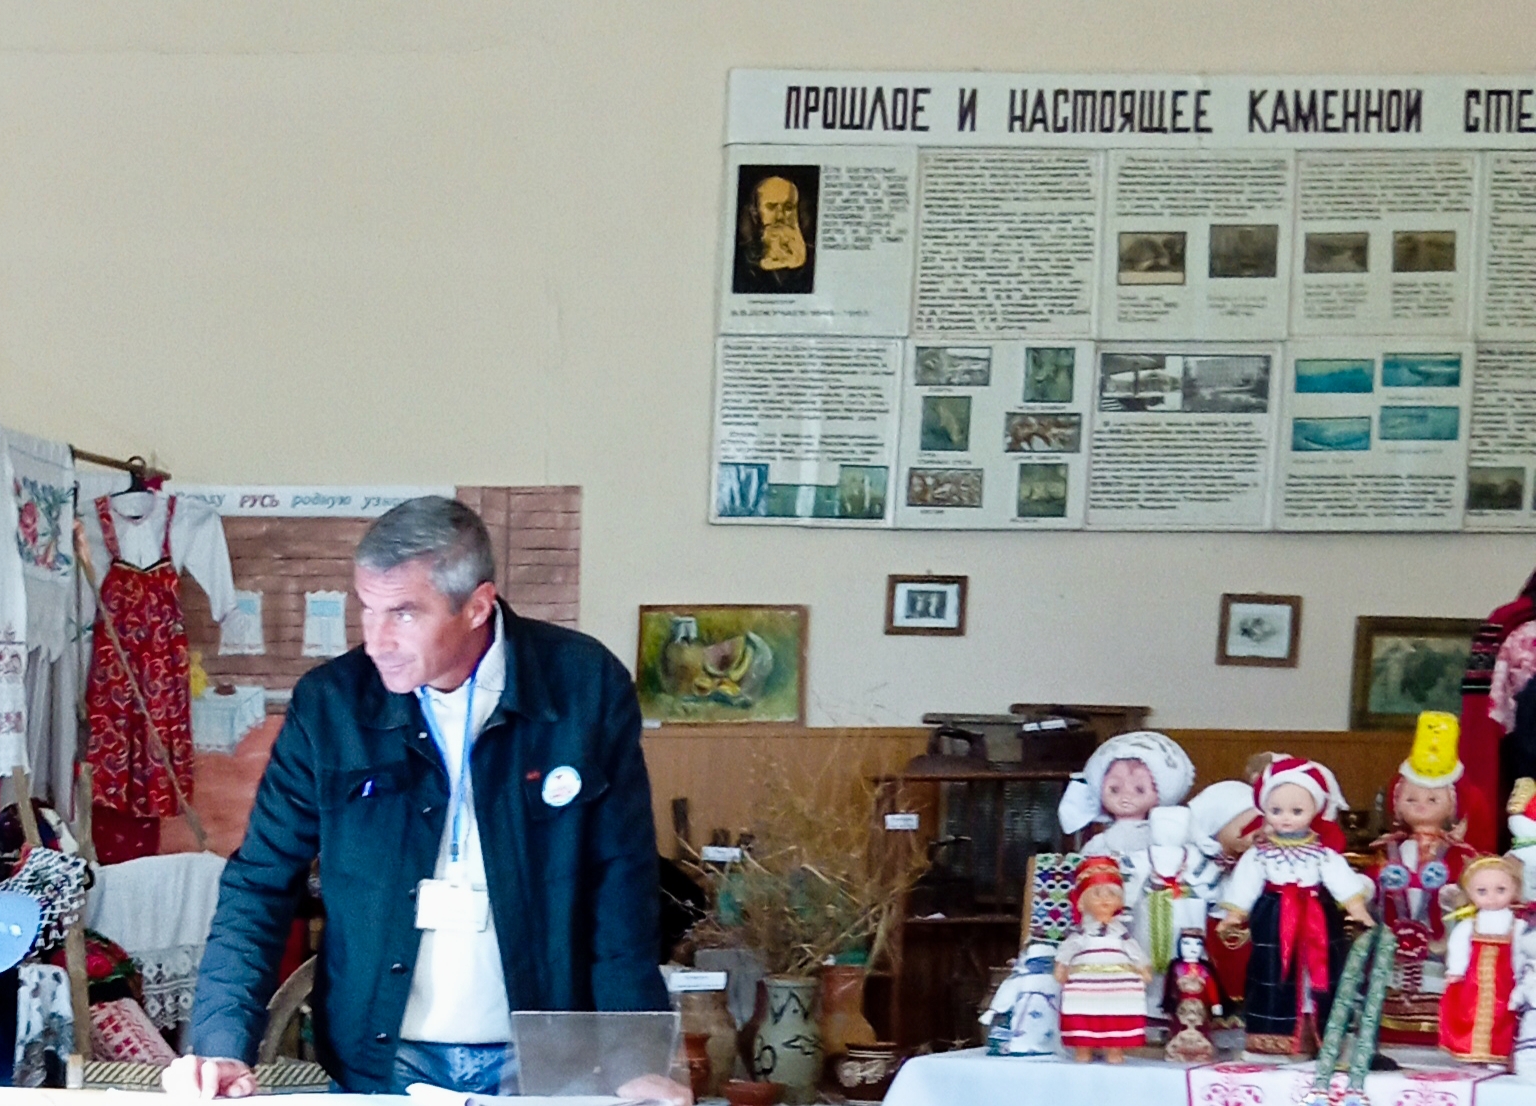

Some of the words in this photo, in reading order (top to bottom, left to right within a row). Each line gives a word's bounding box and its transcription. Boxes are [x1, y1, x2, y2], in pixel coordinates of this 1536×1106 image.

[784, 86, 931, 131] ПРОШЛОЕ
[957, 88, 978, 132] И
[1008, 89, 1214, 133] НАСТОЯЩЕЕ
[1248, 88, 1423, 133] КАМЕННОЙ
